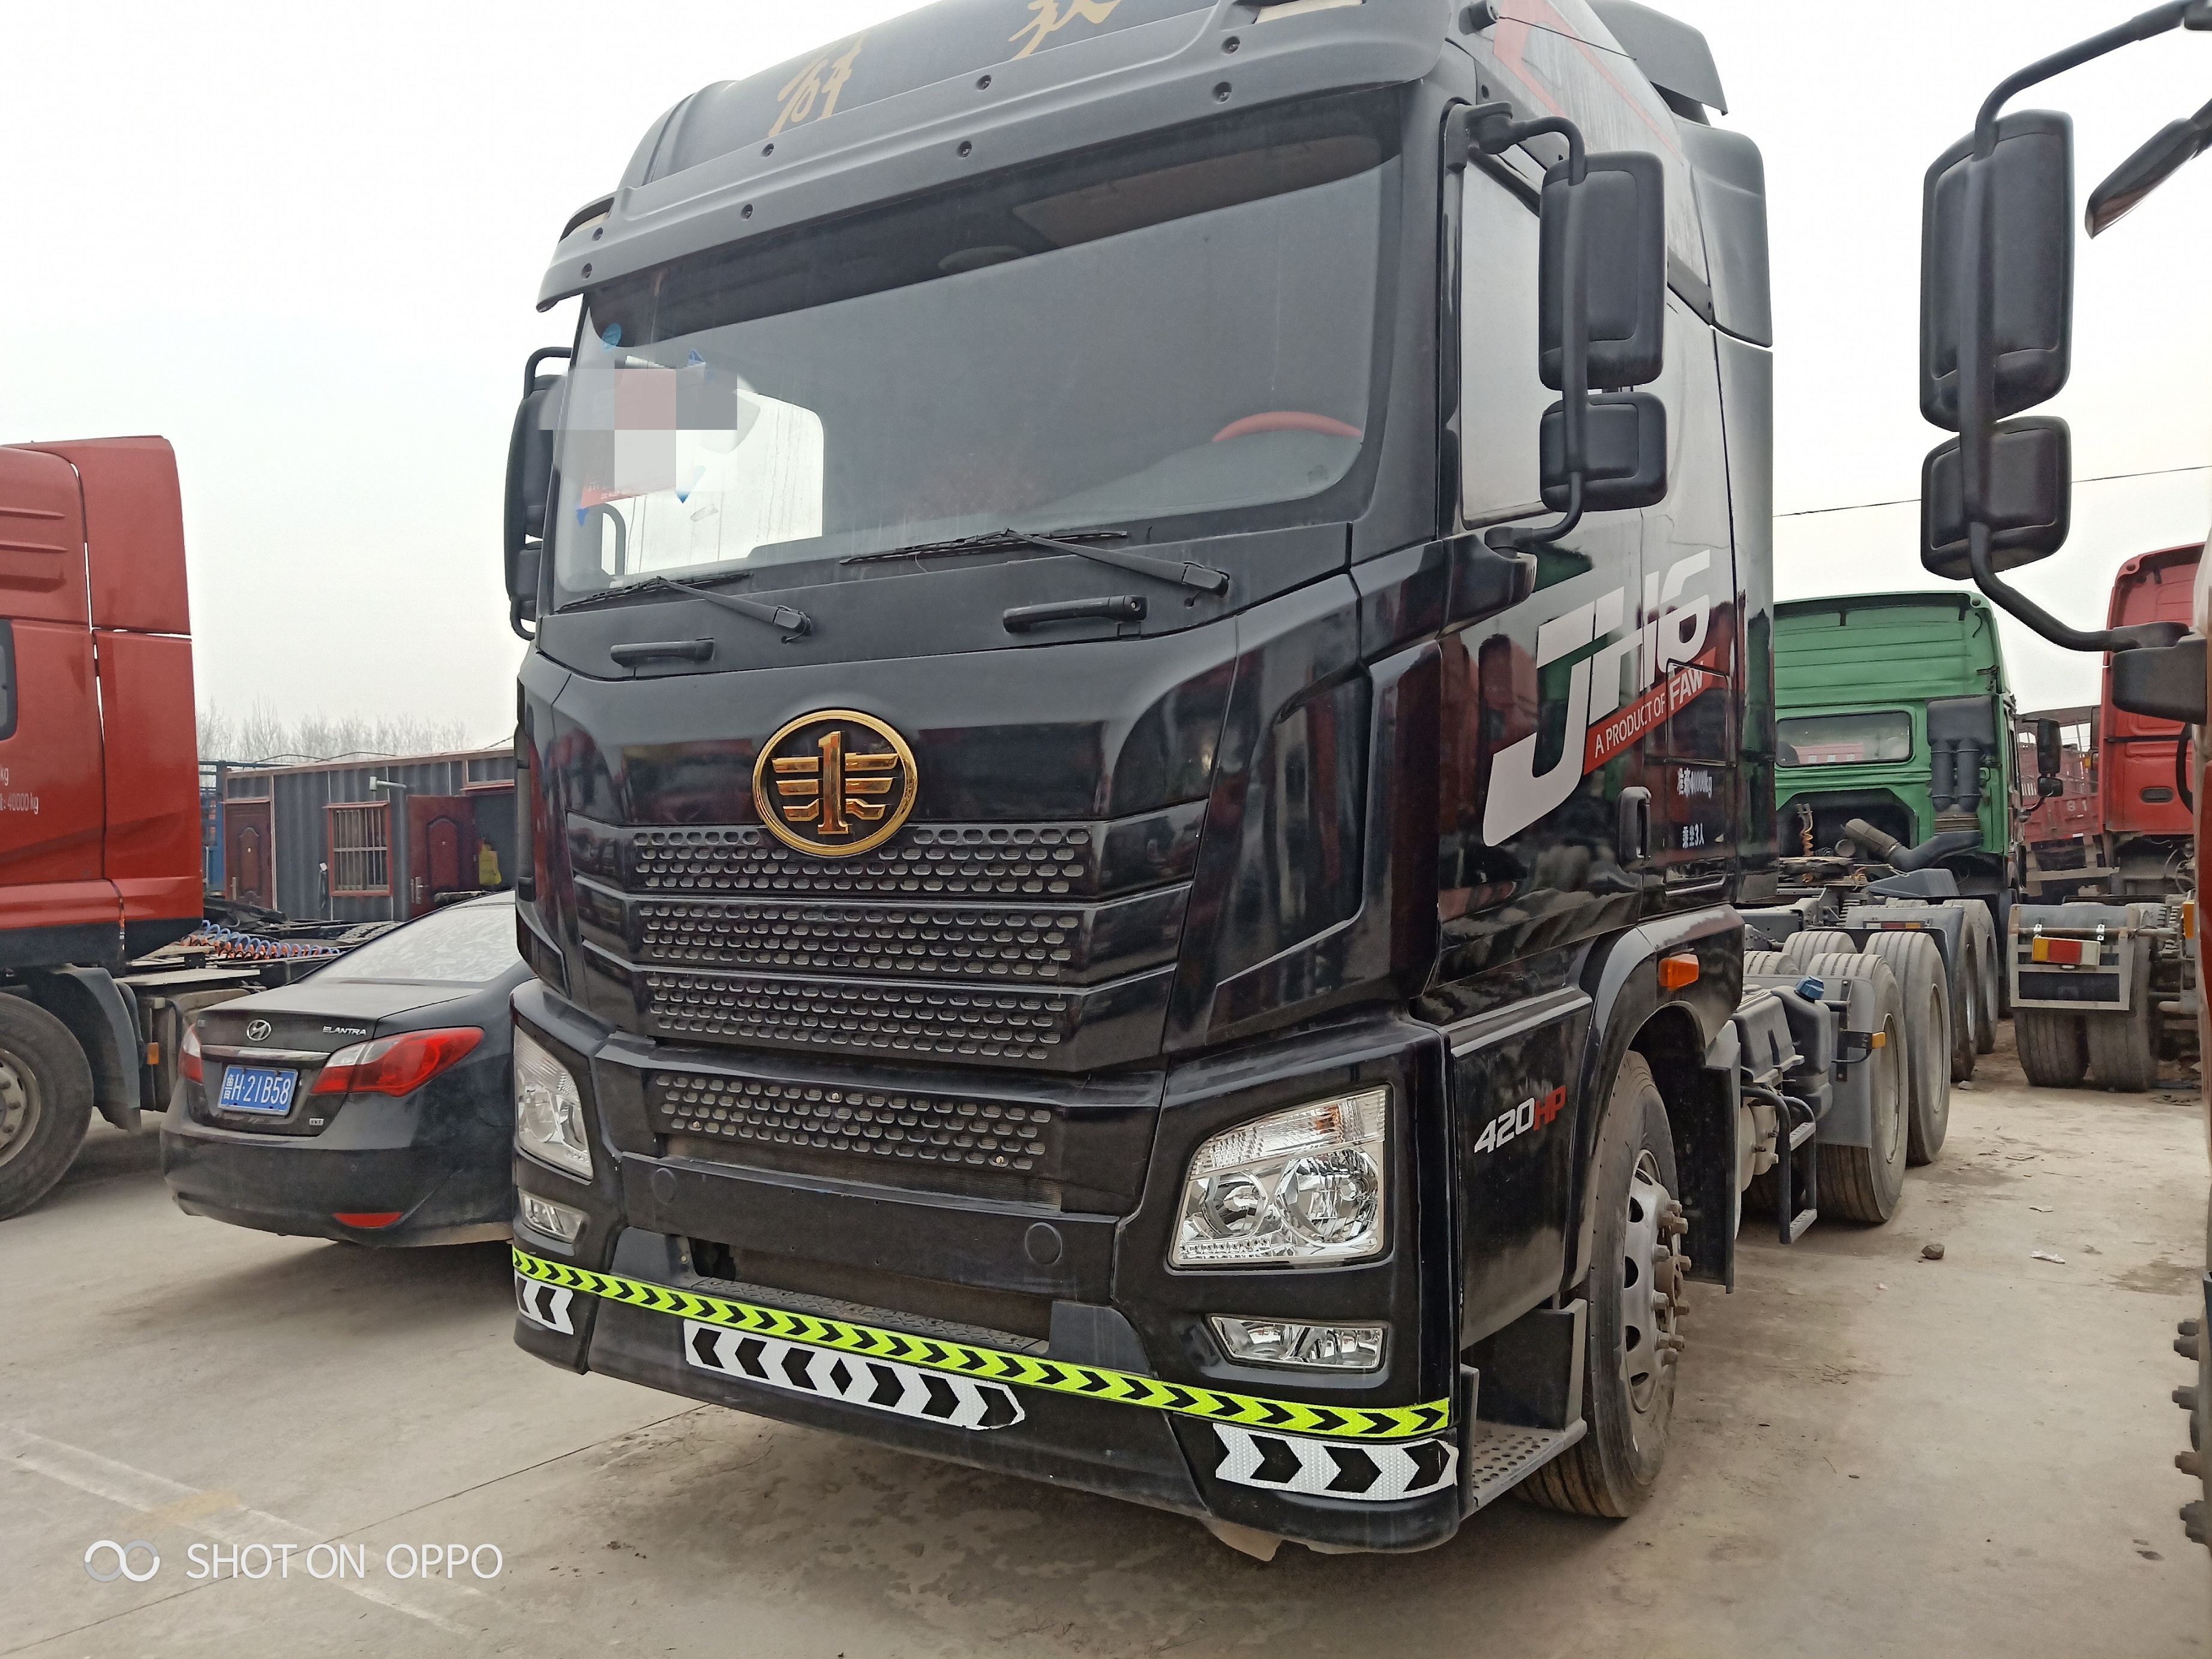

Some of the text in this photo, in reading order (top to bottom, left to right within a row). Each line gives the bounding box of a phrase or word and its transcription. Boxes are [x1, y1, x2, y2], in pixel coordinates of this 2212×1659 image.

[1595, 660, 1704, 759] A PRODUCT OF FAW
[323, 1025, 367, 1036] ELANTRA
